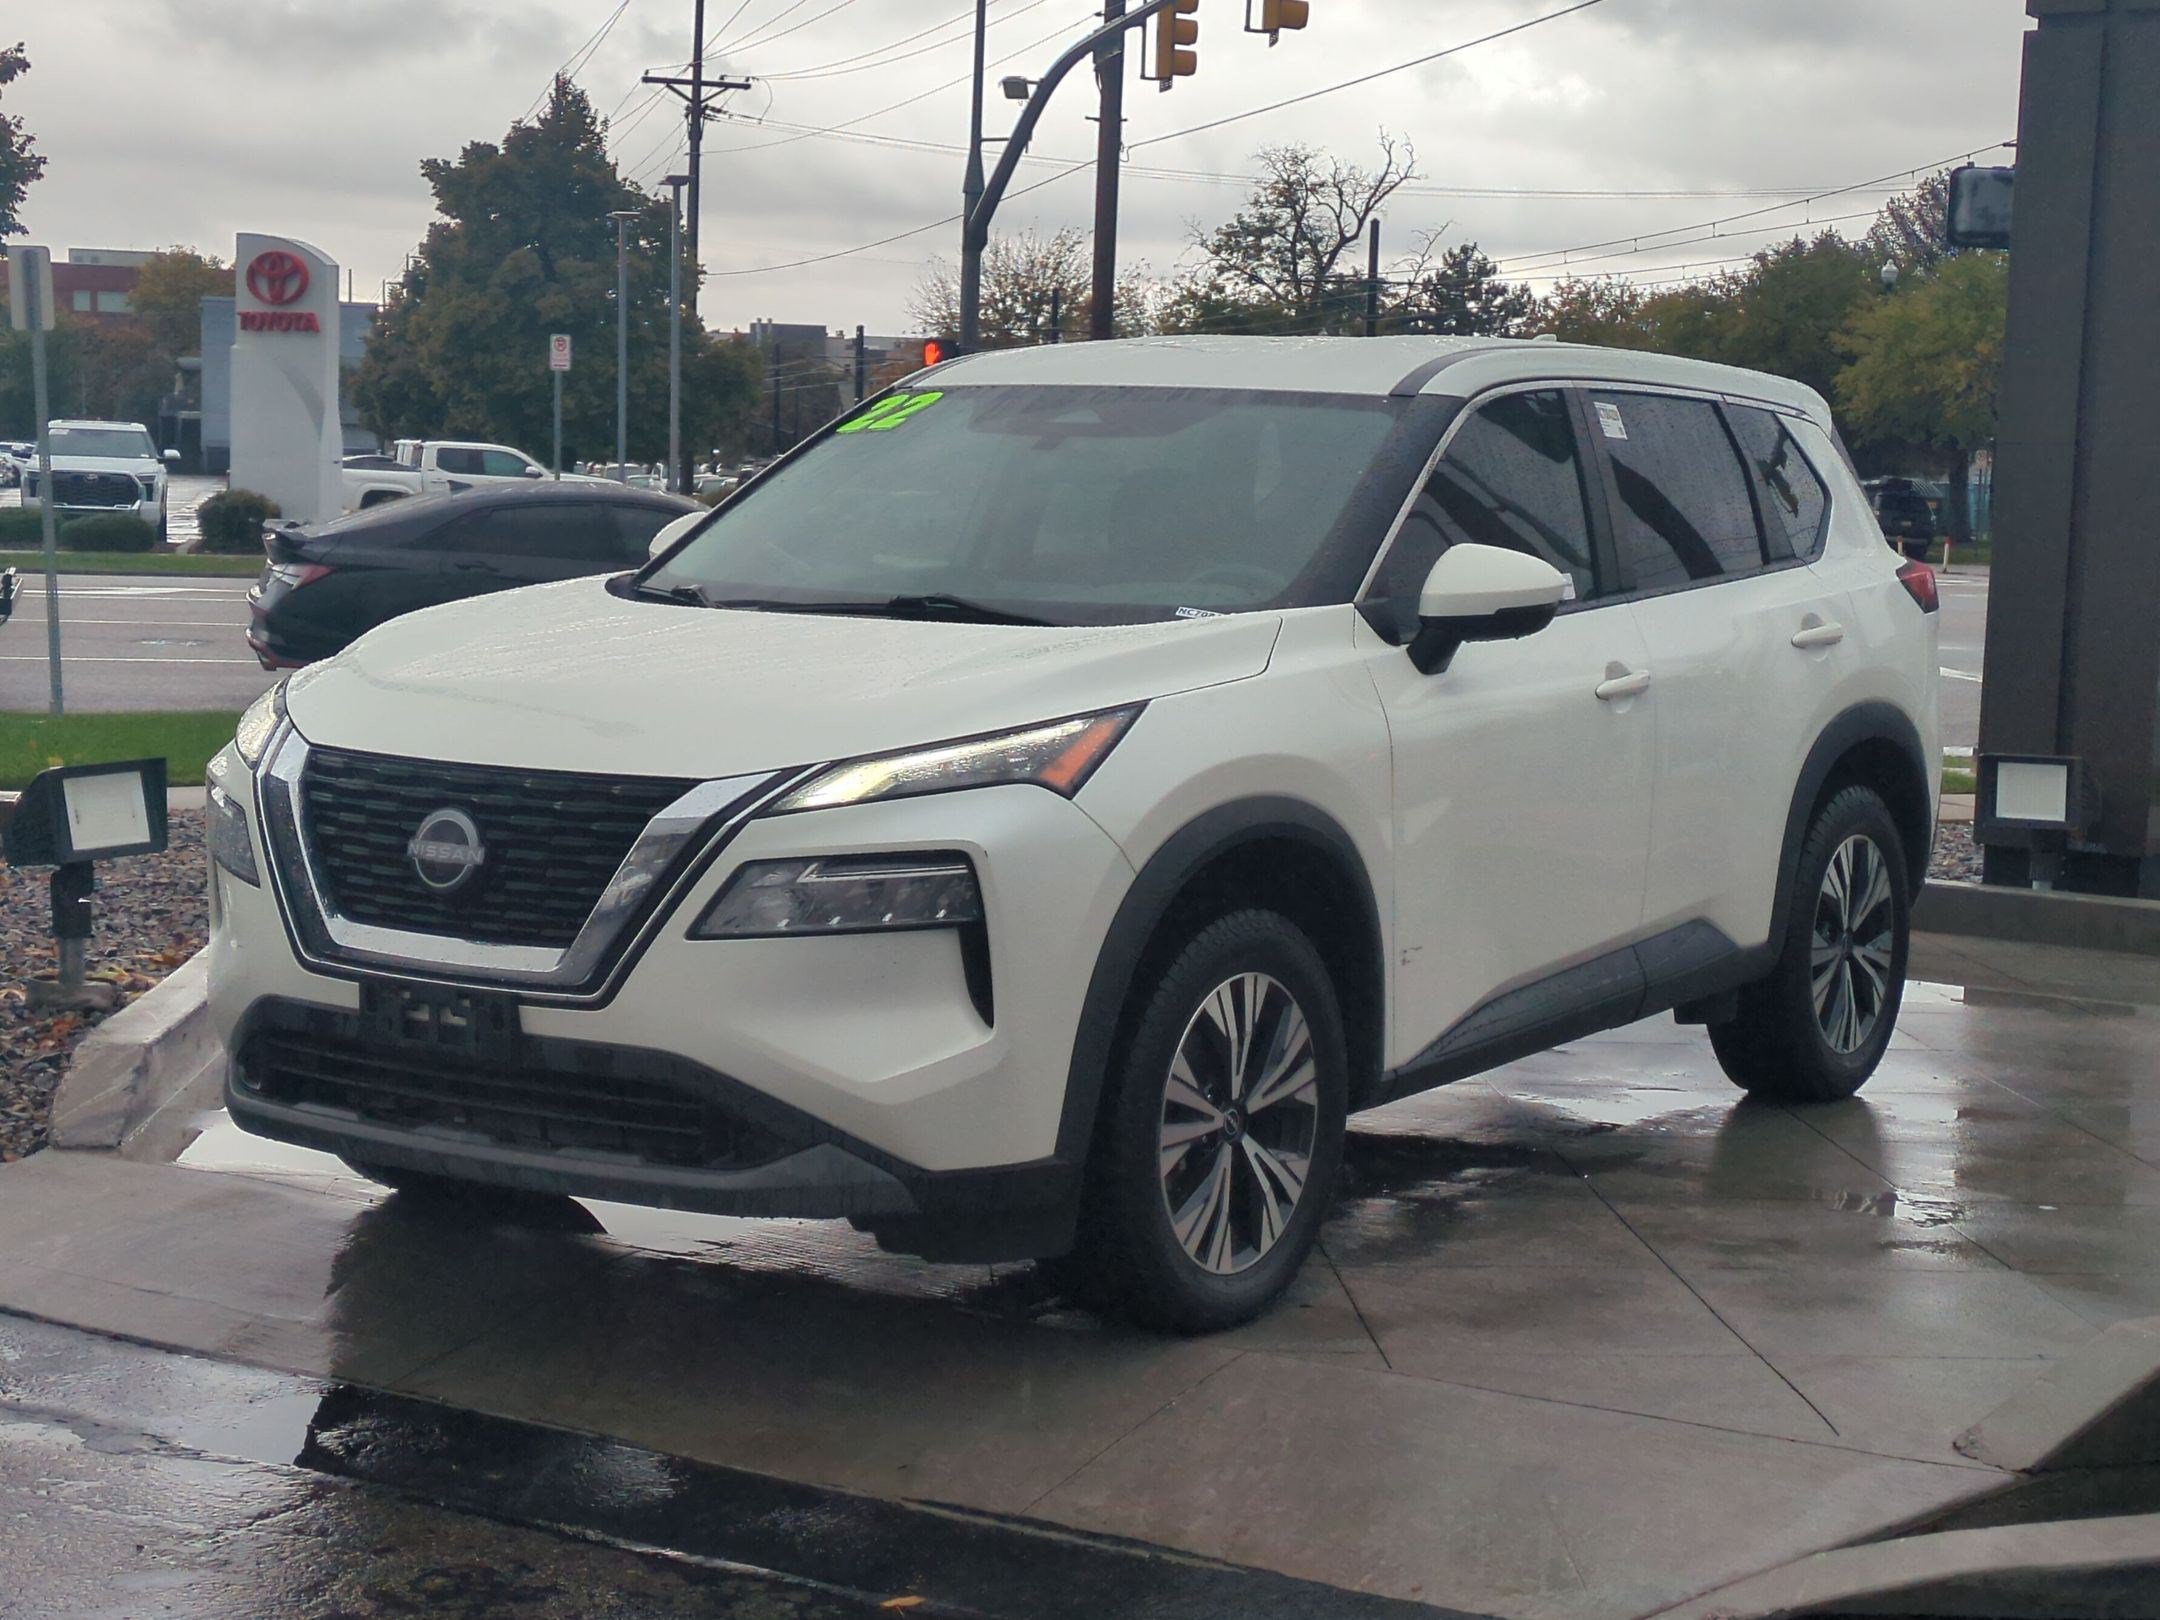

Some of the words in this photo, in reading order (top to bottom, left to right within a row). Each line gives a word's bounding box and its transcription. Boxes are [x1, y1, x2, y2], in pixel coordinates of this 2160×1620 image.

[238, 311, 321, 333] TOYOTA
[836, 391, 944, 433] 22
[408, 841, 483, 864] NISSAN
